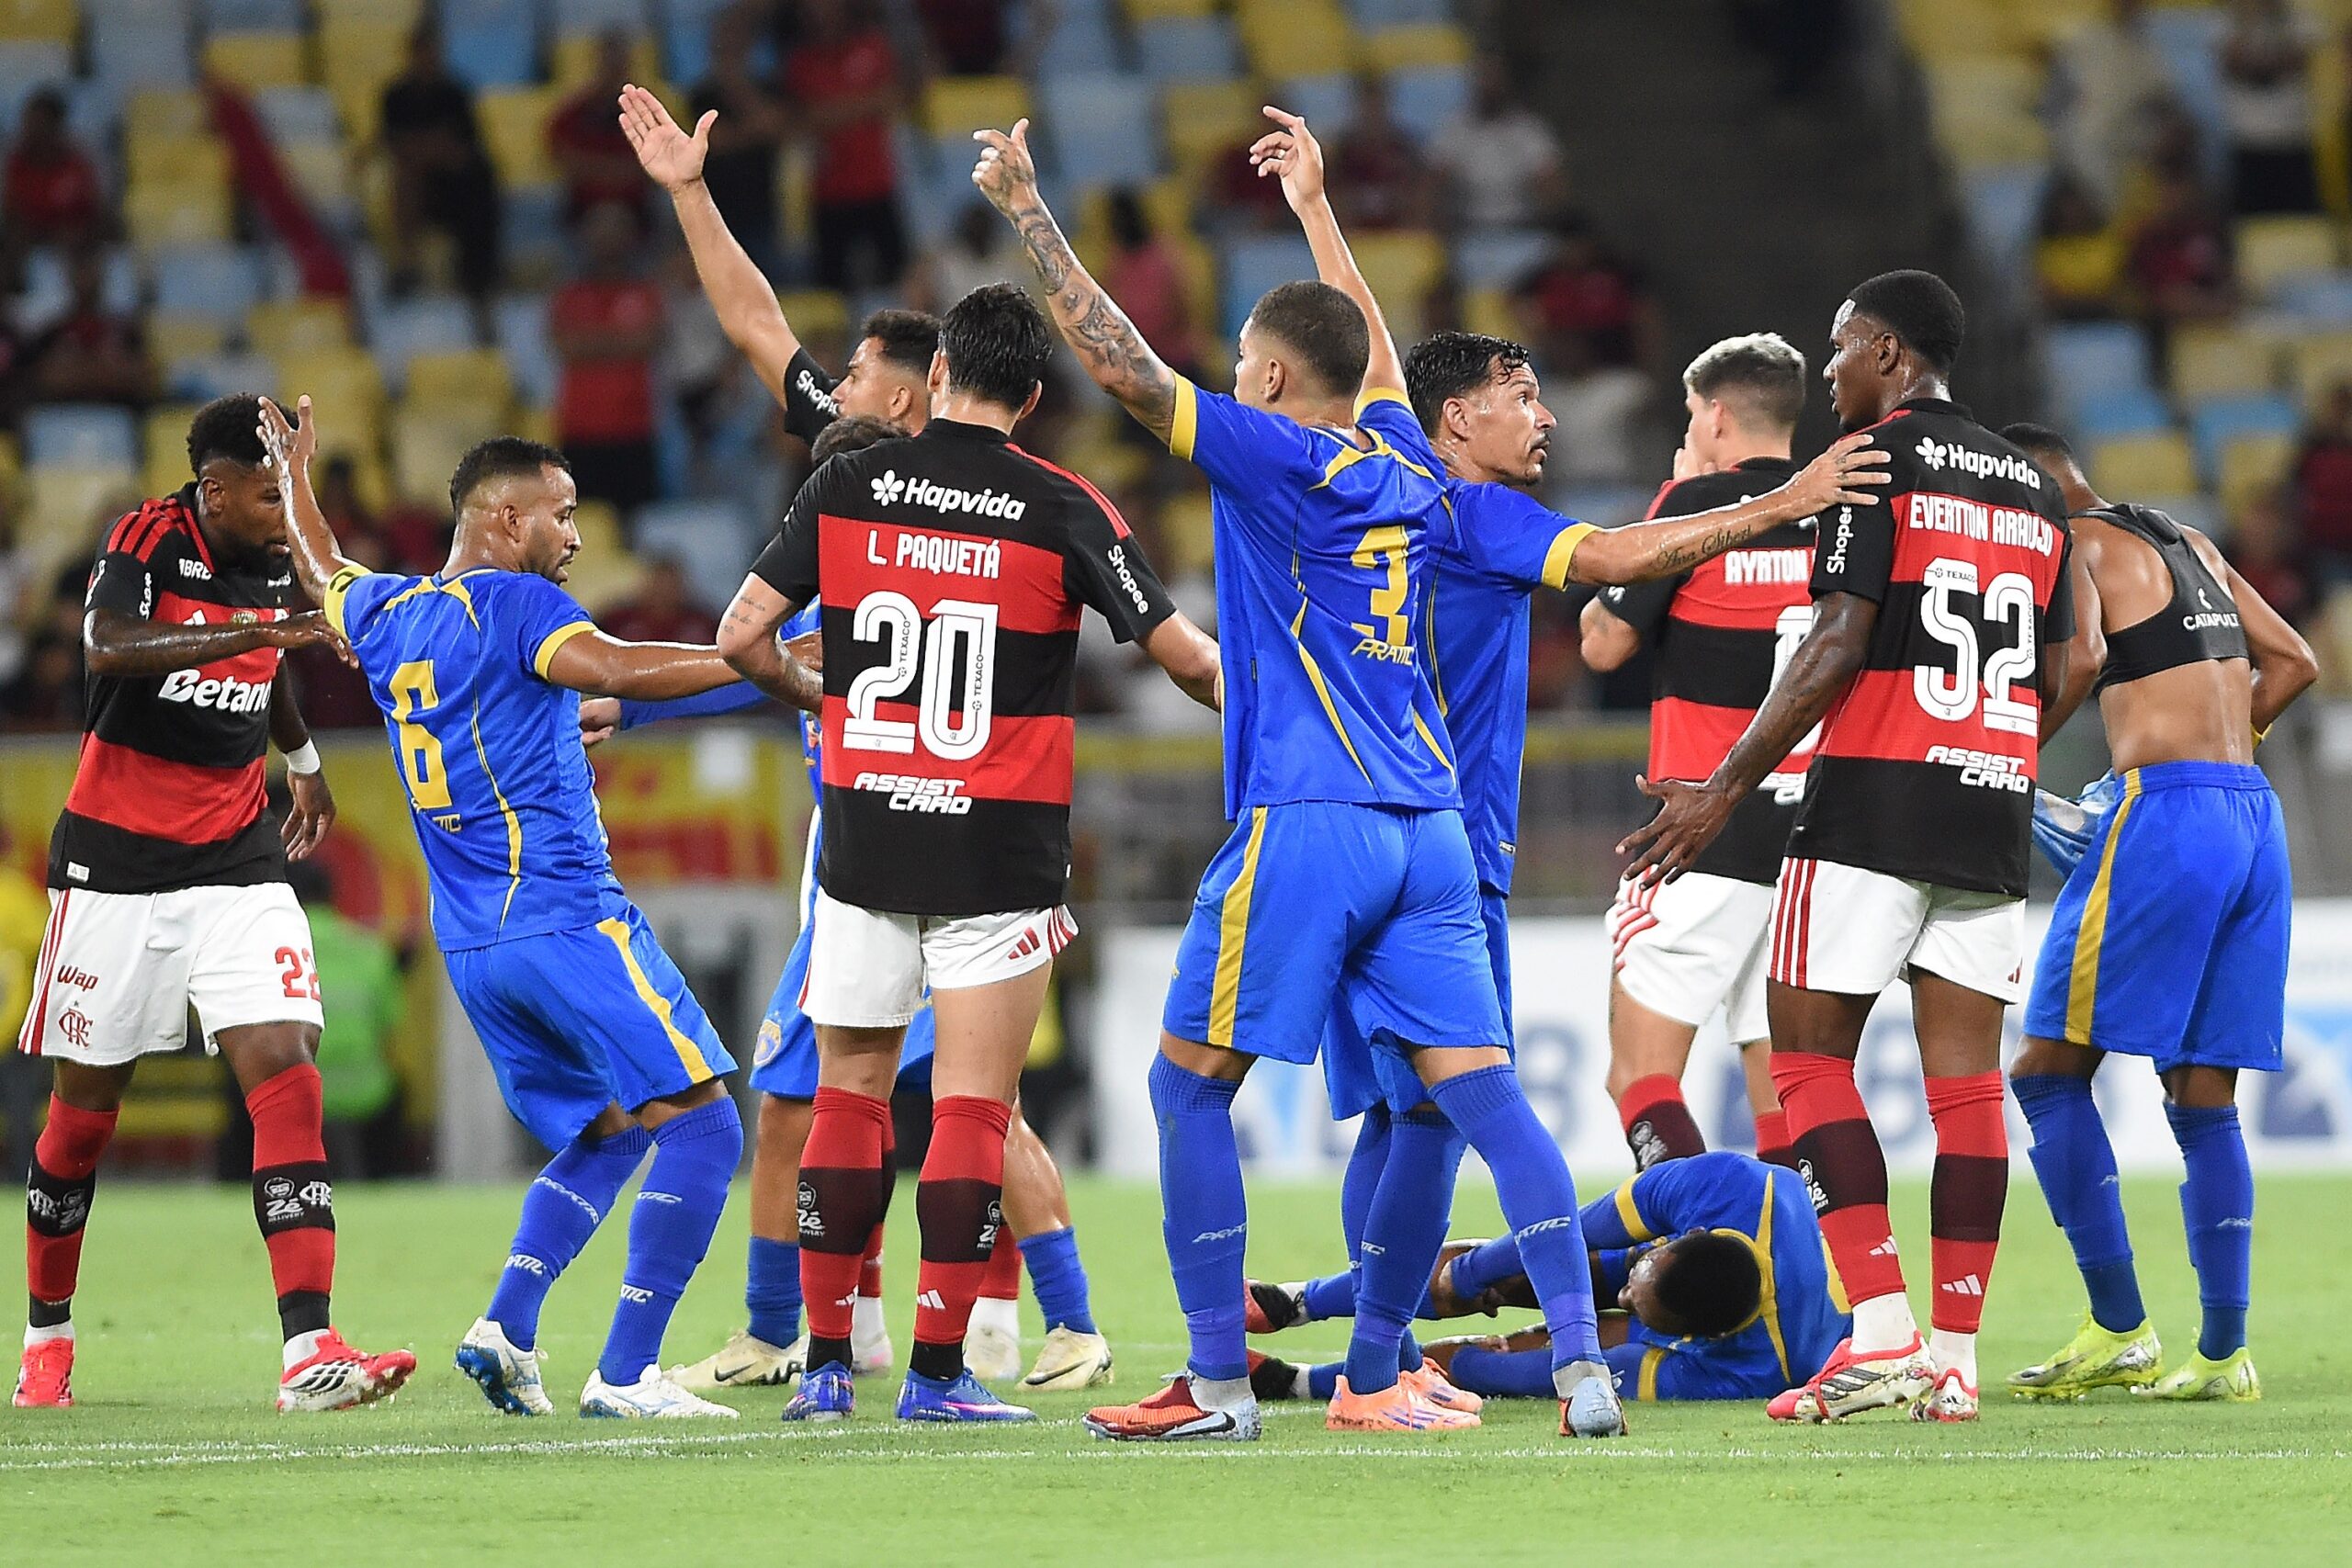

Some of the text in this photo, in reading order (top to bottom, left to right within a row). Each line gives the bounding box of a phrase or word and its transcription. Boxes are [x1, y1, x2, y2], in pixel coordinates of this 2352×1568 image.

[795, 369, 838, 414] Shop
[1947, 443, 2041, 490] Hapvida
[903, 477, 1026, 522] Hapvida
[1909, 494, 2053, 557] EVERTON ARAUJO
[866, 530, 1001, 580] L PAQUETÁ
[1724, 549, 1808, 583] AYRTON
[1108, 545, 1149, 615] Shopee
[1351, 525, 1409, 646] 3
[899, 620, 912, 662] TEXACO
[2183, 613, 2240, 630] CATAPULT
[1912, 557, 2038, 739] 52
[158, 669, 273, 712] Betano
[842, 591, 1000, 761] 20
[974, 653, 985, 696] TEXACO
[389, 659, 453, 808] 6
[1925, 745, 2026, 773] ASSIST
[1960, 766, 2030, 794] CARD
[854, 773, 966, 797] ASSIST
[888, 793, 973, 816] CARD
[57, 964, 98, 992] Wap
[266, 1197, 303, 1217] Zé
